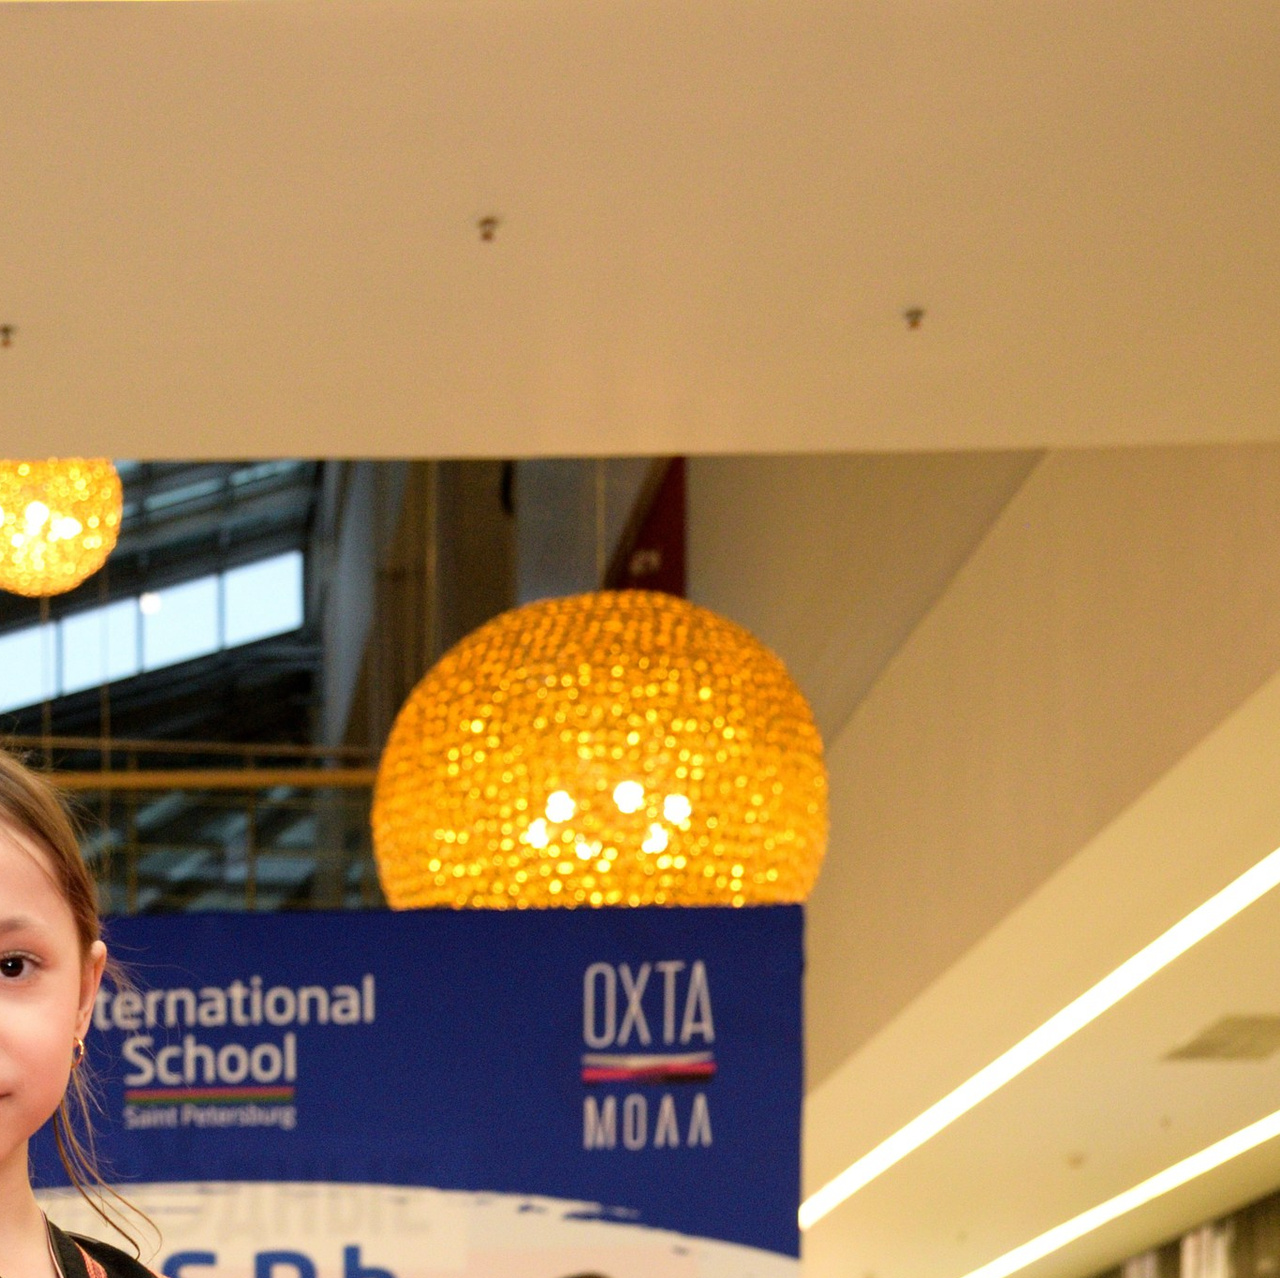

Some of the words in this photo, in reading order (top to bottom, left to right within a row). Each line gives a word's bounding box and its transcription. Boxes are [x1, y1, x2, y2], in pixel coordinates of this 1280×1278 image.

[92, 974, 376, 1031] ternational
[583, 960, 716, 1050] ОХТА
[121, 1031, 297, 1087] School
[122, 1104, 177, 1130] Saint
[180, 1102, 297, 1131] Petersburg
[583, 1092, 713, 1151] МОЛЛ
